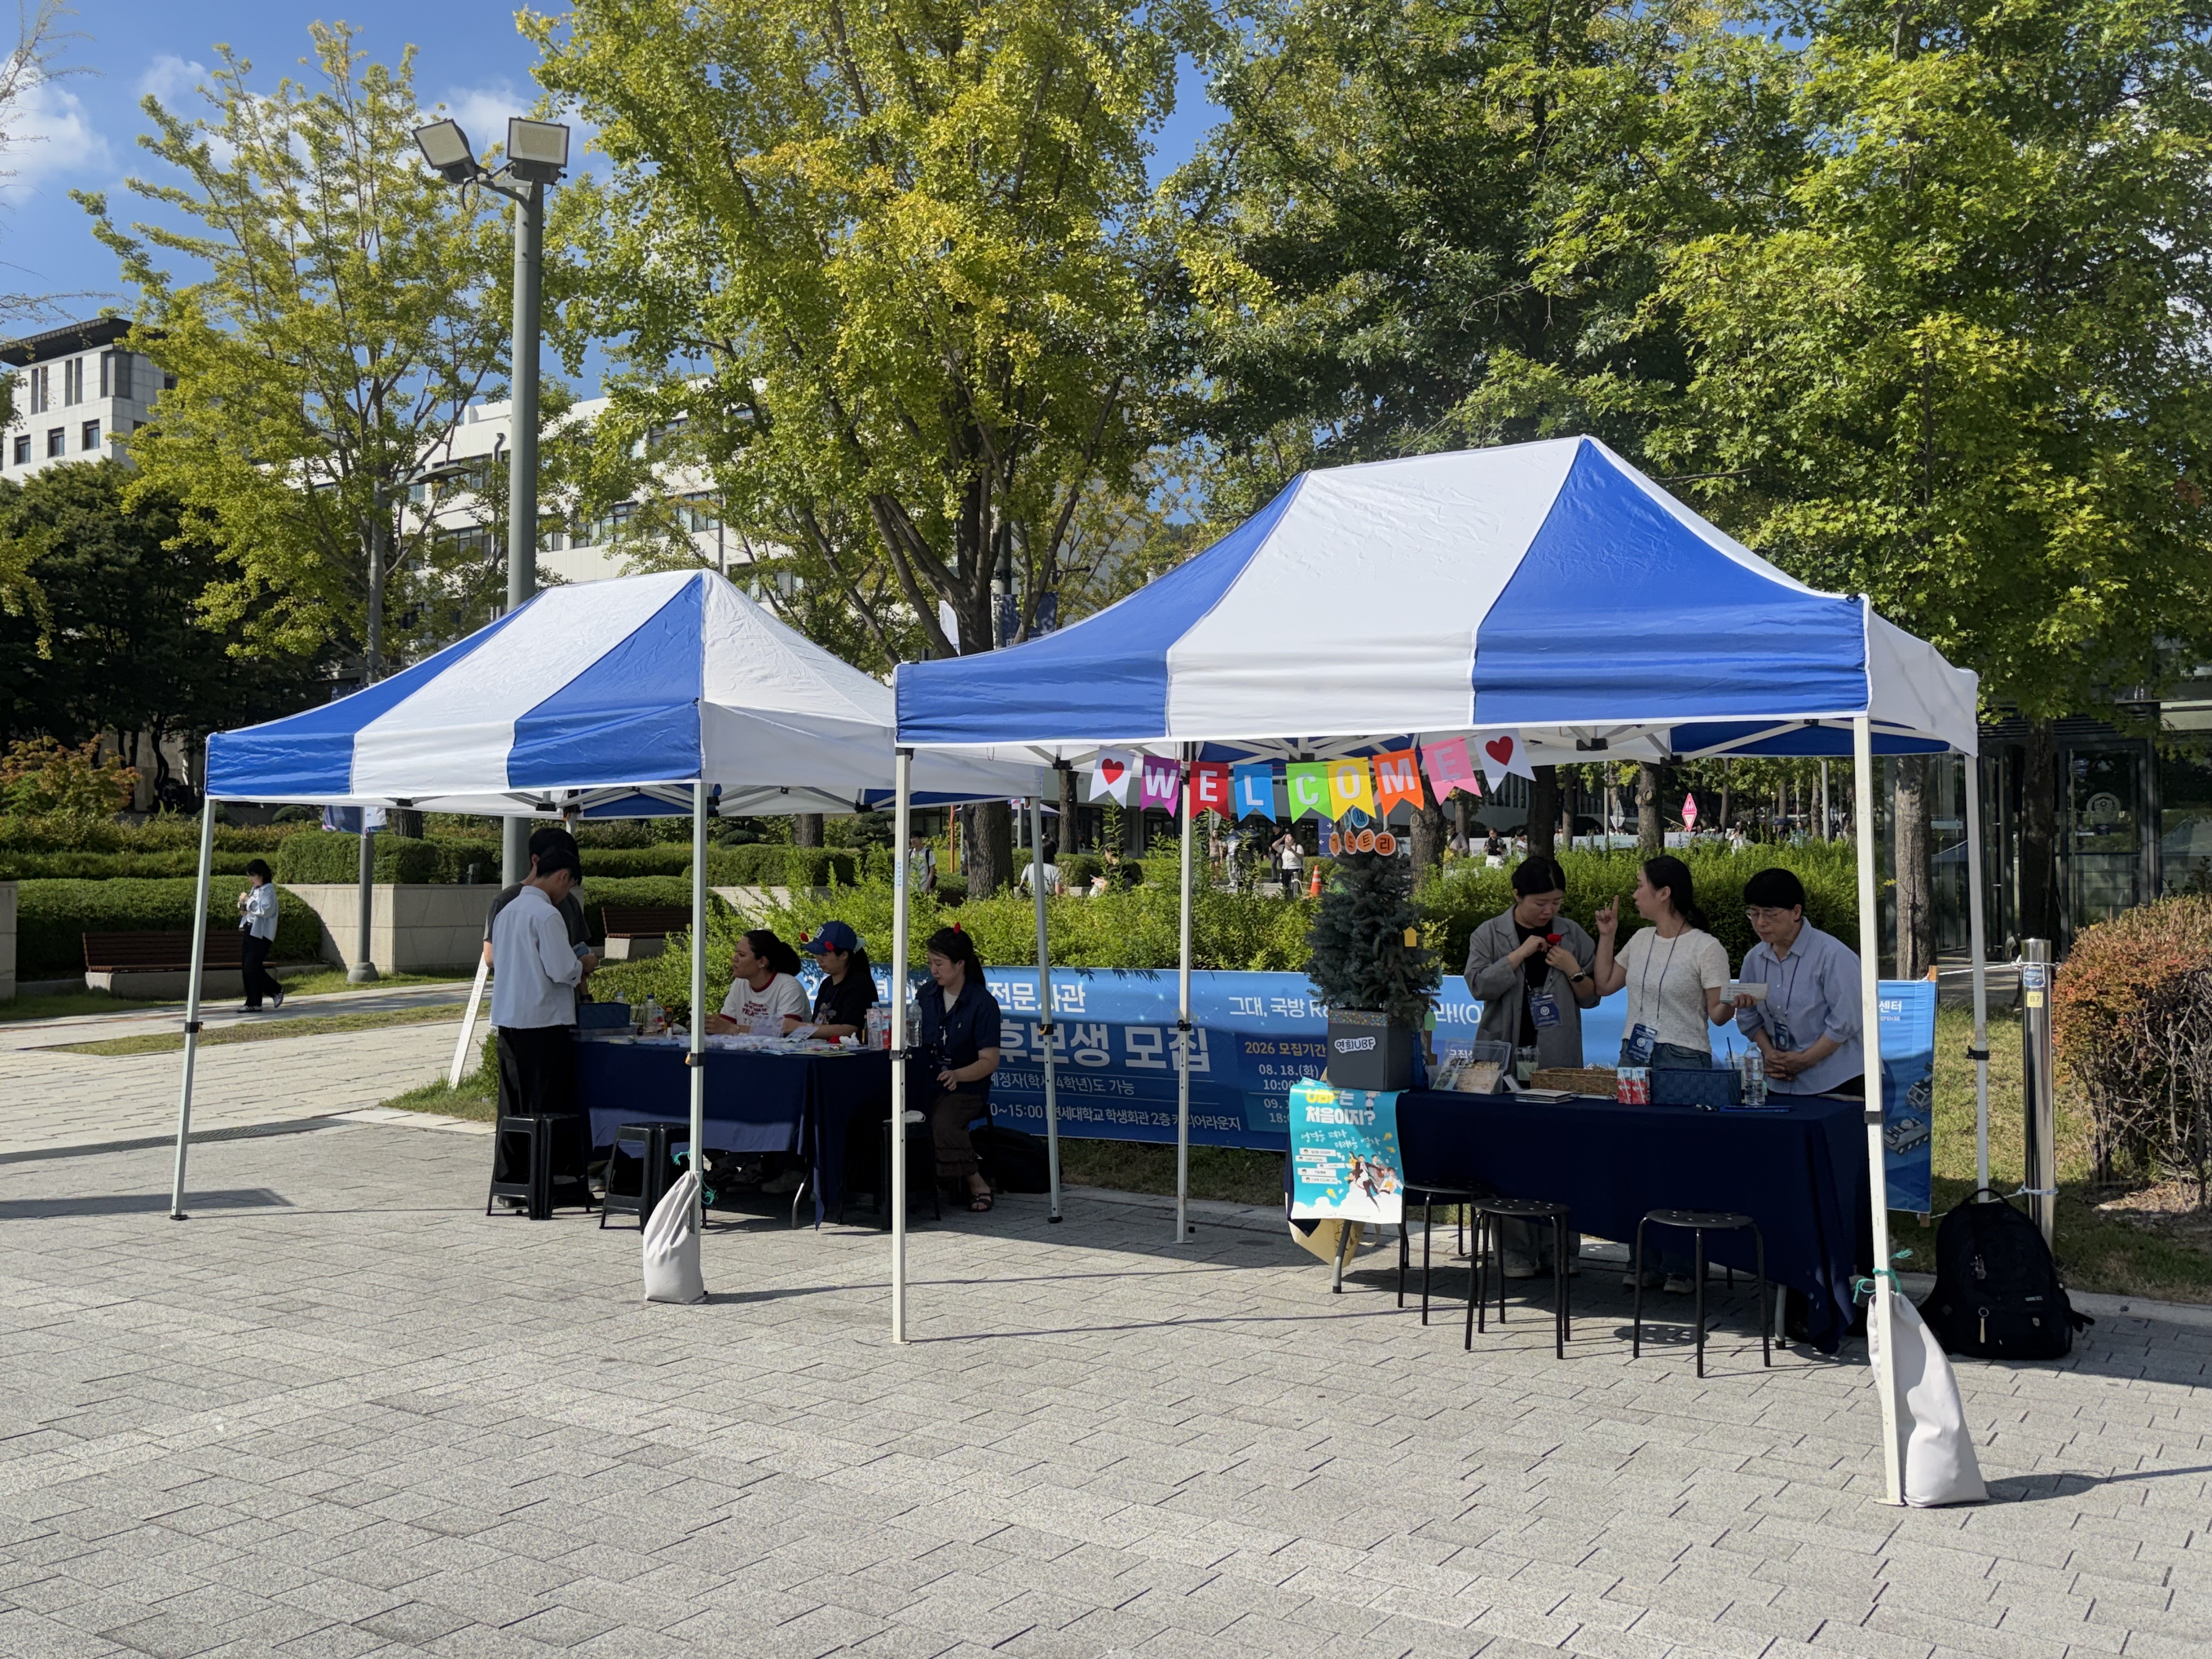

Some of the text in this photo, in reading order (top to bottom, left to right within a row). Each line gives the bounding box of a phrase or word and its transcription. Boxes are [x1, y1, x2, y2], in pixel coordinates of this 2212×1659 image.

[1144, 747, 1462, 806] WELCOME
[1228, 996, 1268, 1018] 그대,
[1270, 997, 1305, 1018] 국방
[1878, 1000, 1902, 1013] 센터
[1000, 1019, 1210, 1073] 후보생 모집
[1244, 1041, 1327, 1057] 2026 모집기간
[1336, 1038, 1374, 1051] 연희UBF
[1259, 1064, 1319, 1079] 08. 18.(화)
[1109, 1079, 1135, 1095] 가능
[1106, 1108, 1149, 1126] 학생회관
[1150, 1112, 1171, 1126] 2층
[1305, 1105, 1376, 1126] 처음이지?
